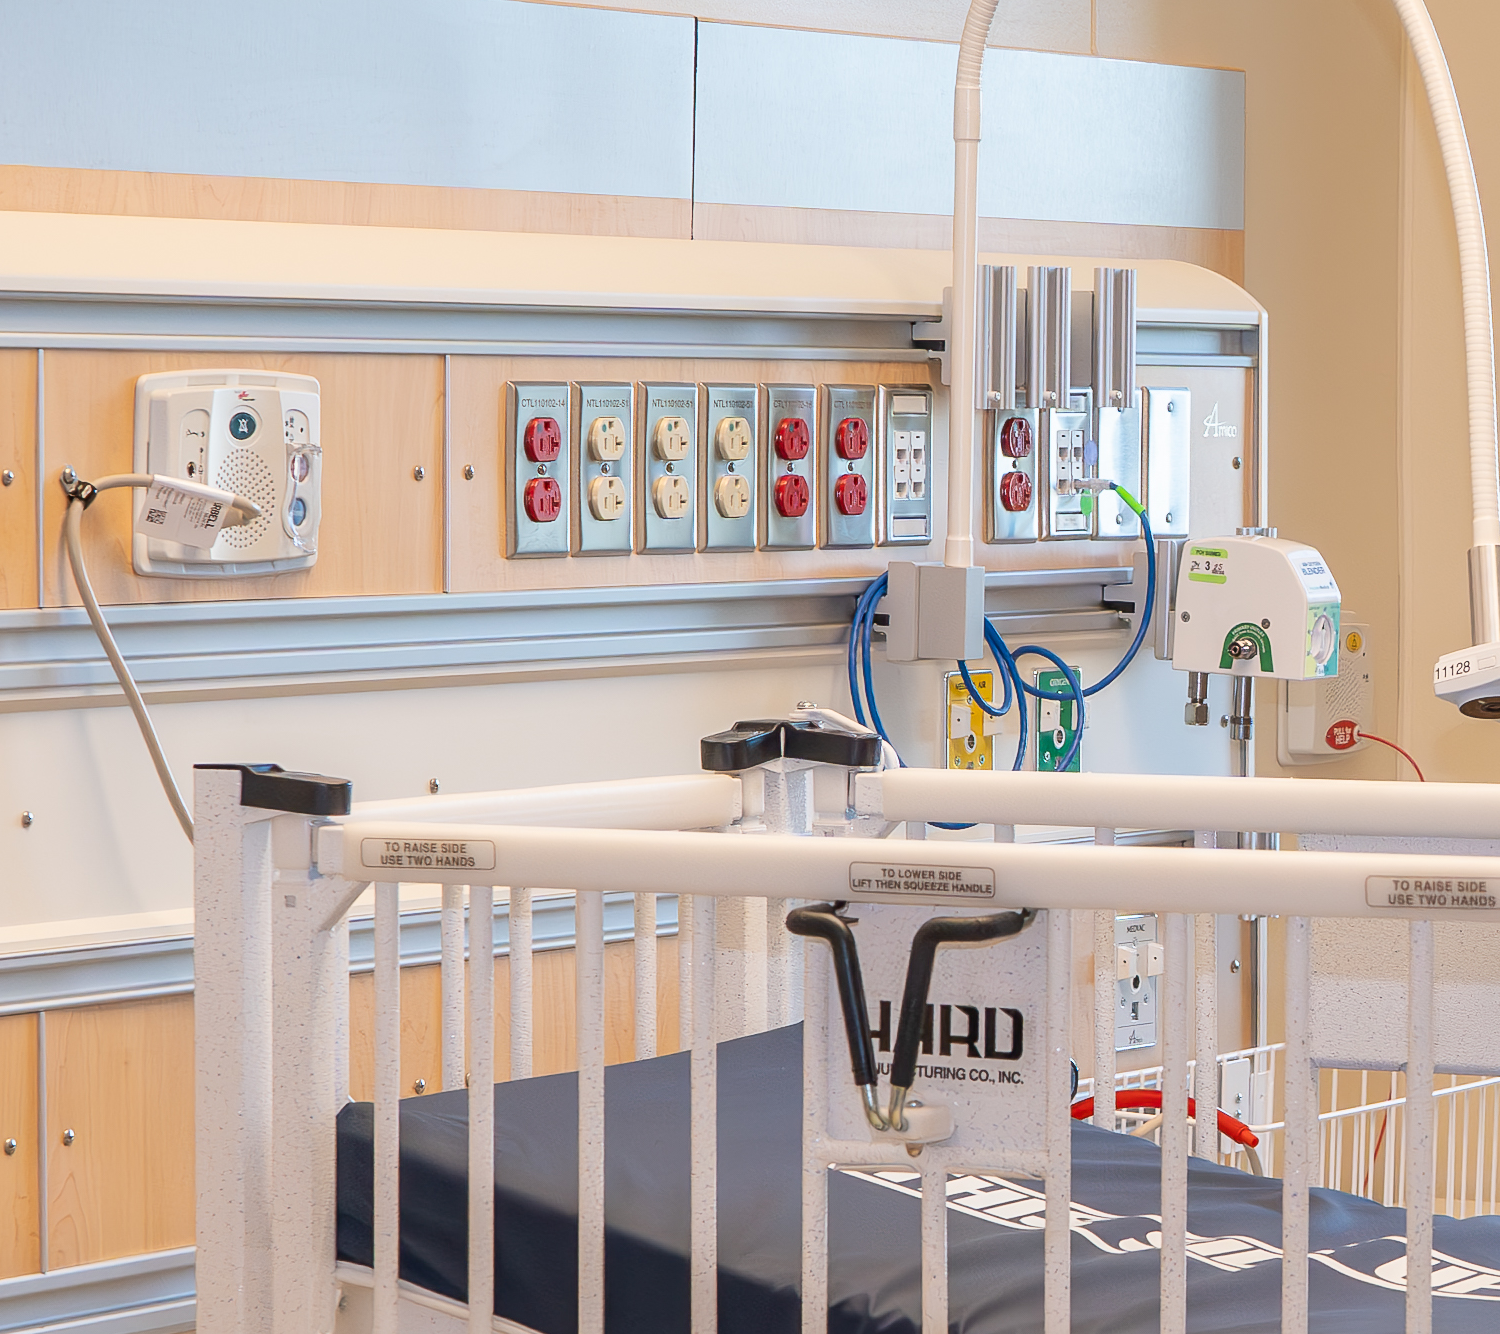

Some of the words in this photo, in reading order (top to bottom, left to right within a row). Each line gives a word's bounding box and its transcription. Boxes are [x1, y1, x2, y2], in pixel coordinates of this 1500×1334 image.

[1203, 400, 1237, 437] Amico
[1301, 566, 1326, 576] BLENDER
[1435, 660, 1471, 680] 11128
[1335, 736, 1350, 745] HELP
[385, 841, 400, 852] TO
[404, 842, 437, 854] RAISE
[441, 843, 467, 854] SIDE
[381, 855, 403, 865] USE
[407, 855, 432, 866] TWO
[436, 856, 475, 867] HANDS
[881, 868, 895, 878] TO
[899, 869, 934, 880] LOWER
[939, 870, 962, 881] SIDE
[852, 879, 872, 888] LIFT
[875, 880, 901, 890] THEN
[903, 881, 949, 892] SQUEEZE
[952, 883, 992, 894] HANDLE
[1393, 879, 1410, 891] TO
[1414, 880, 1452, 892] RAISE
[1458, 881, 1487, 893] SIDE
[1388, 894, 1414, 905] USE
[1419, 894, 1446, 906] TWO
[1451, 895, 1496, 907] HANDS
[969, 1069, 995, 1085] CO.,
[999, 1070, 1024, 1085] INC.
